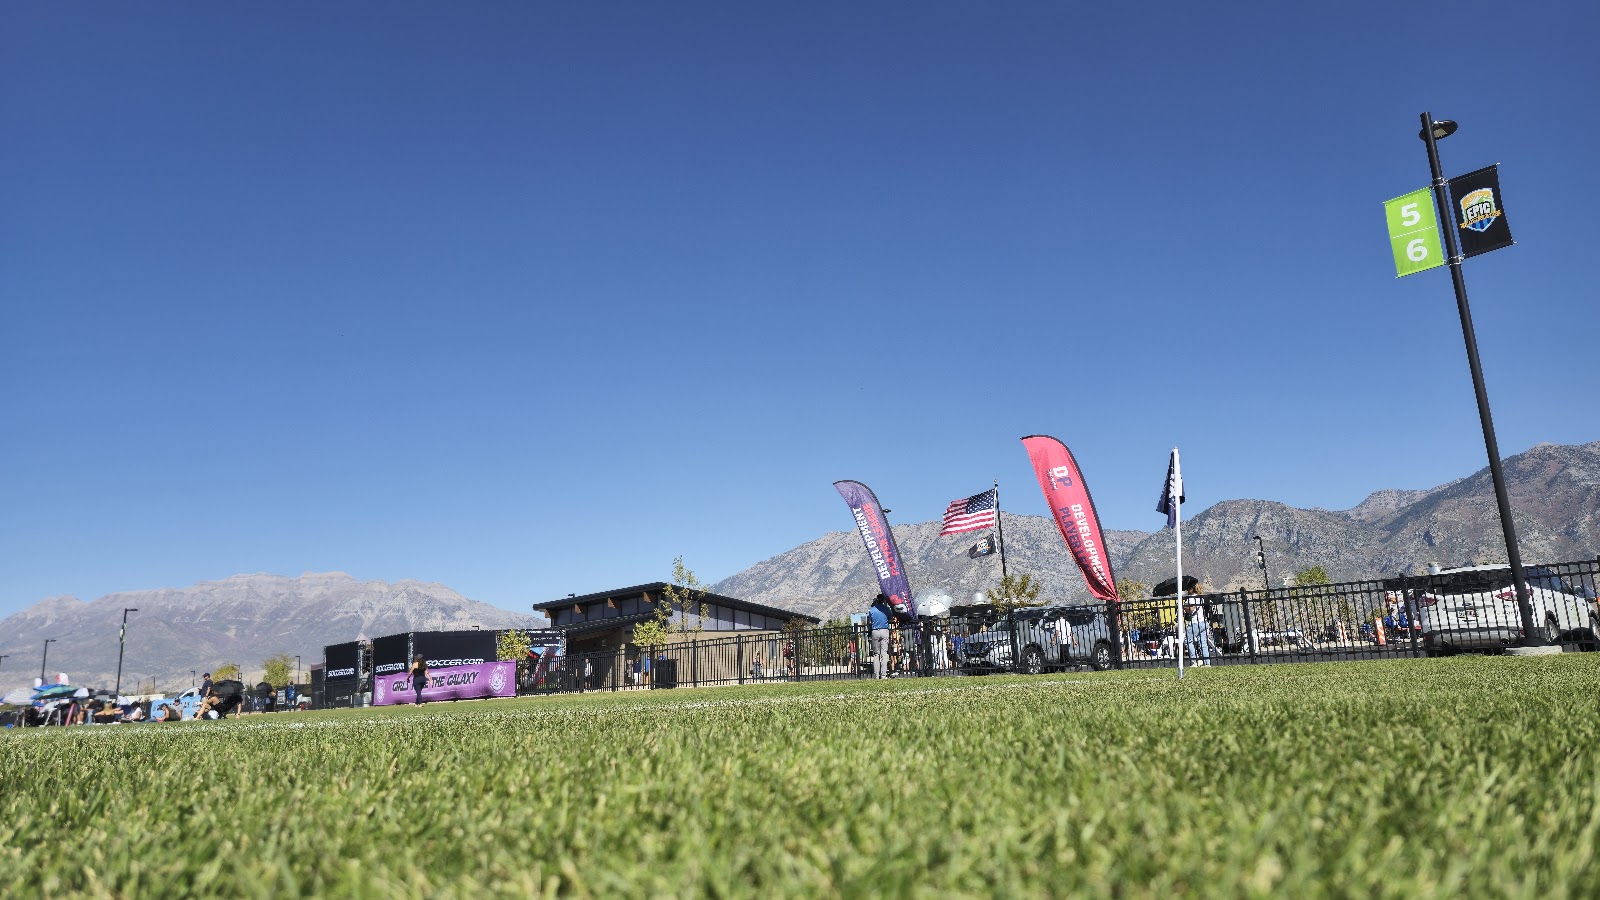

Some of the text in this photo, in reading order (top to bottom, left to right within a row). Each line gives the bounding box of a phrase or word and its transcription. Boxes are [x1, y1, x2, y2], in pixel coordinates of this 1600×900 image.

[1401, 203, 1421, 227] 5
[1466, 202, 1491, 221] EPIC
[1406, 238, 1428, 262] 6
[1059, 506, 1082, 551] PLAYER
[852, 507, 891, 580] DEVELOPMENT
[431, 675, 446, 689] THE
[446, 671, 480, 687] GALAXY
